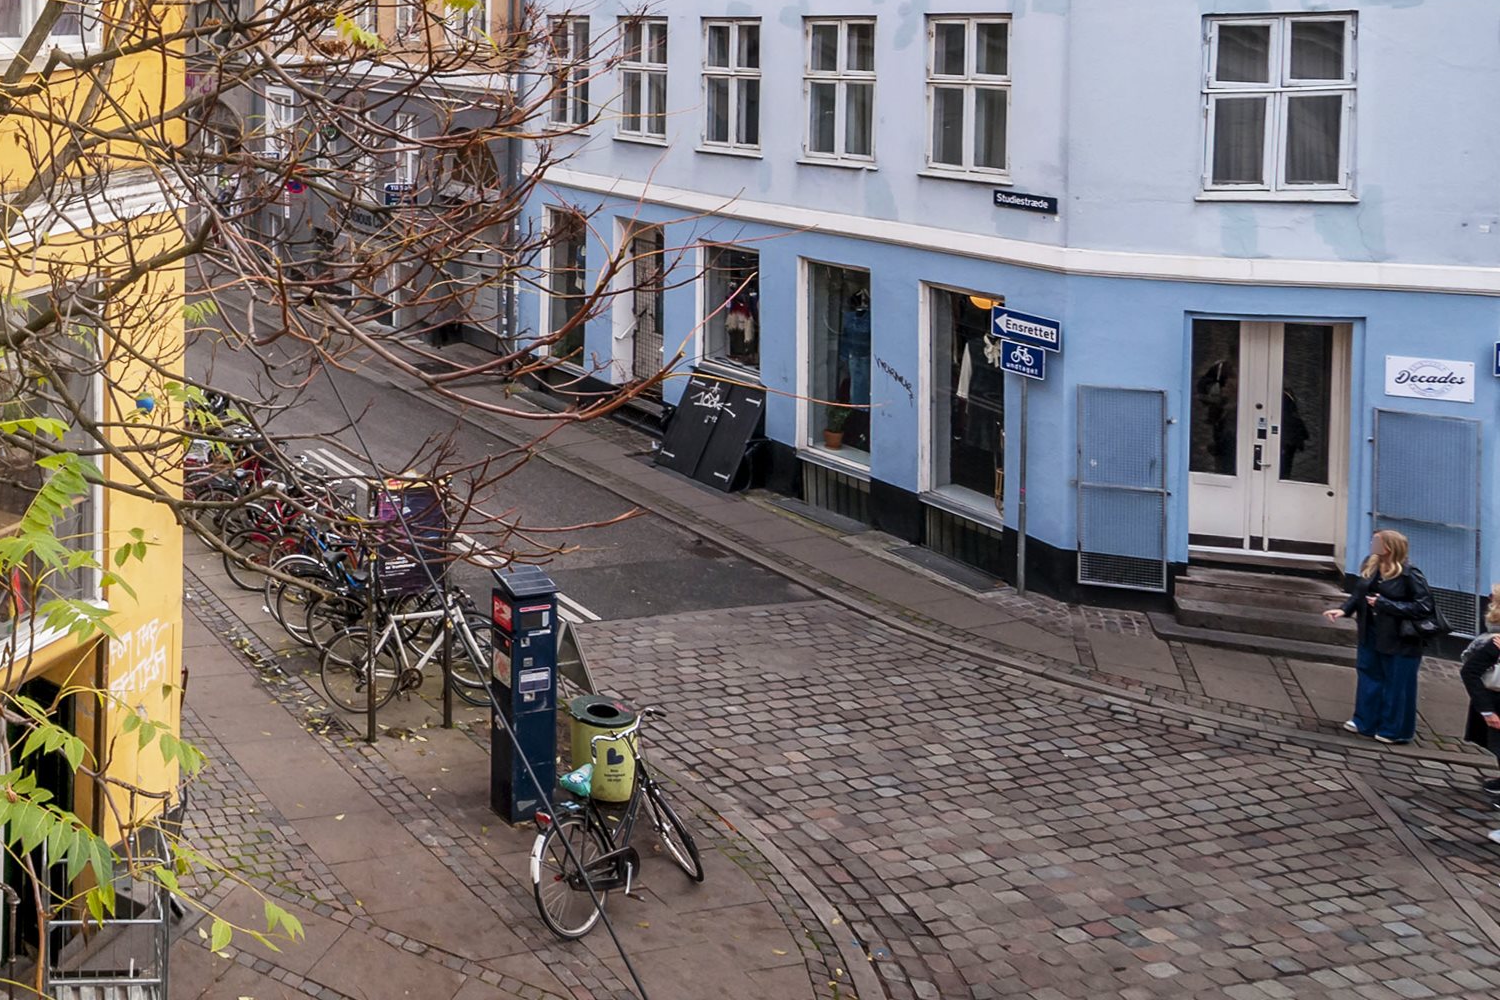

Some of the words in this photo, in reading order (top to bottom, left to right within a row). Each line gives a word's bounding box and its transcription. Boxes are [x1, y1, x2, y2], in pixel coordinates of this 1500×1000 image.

[996, 193, 1049, 209] Studiestræde
[1005, 318, 1055, 341] Ensrettet
[1005, 362, 1039, 376] undtaget
[1394, 369, 1466, 385] Decades
